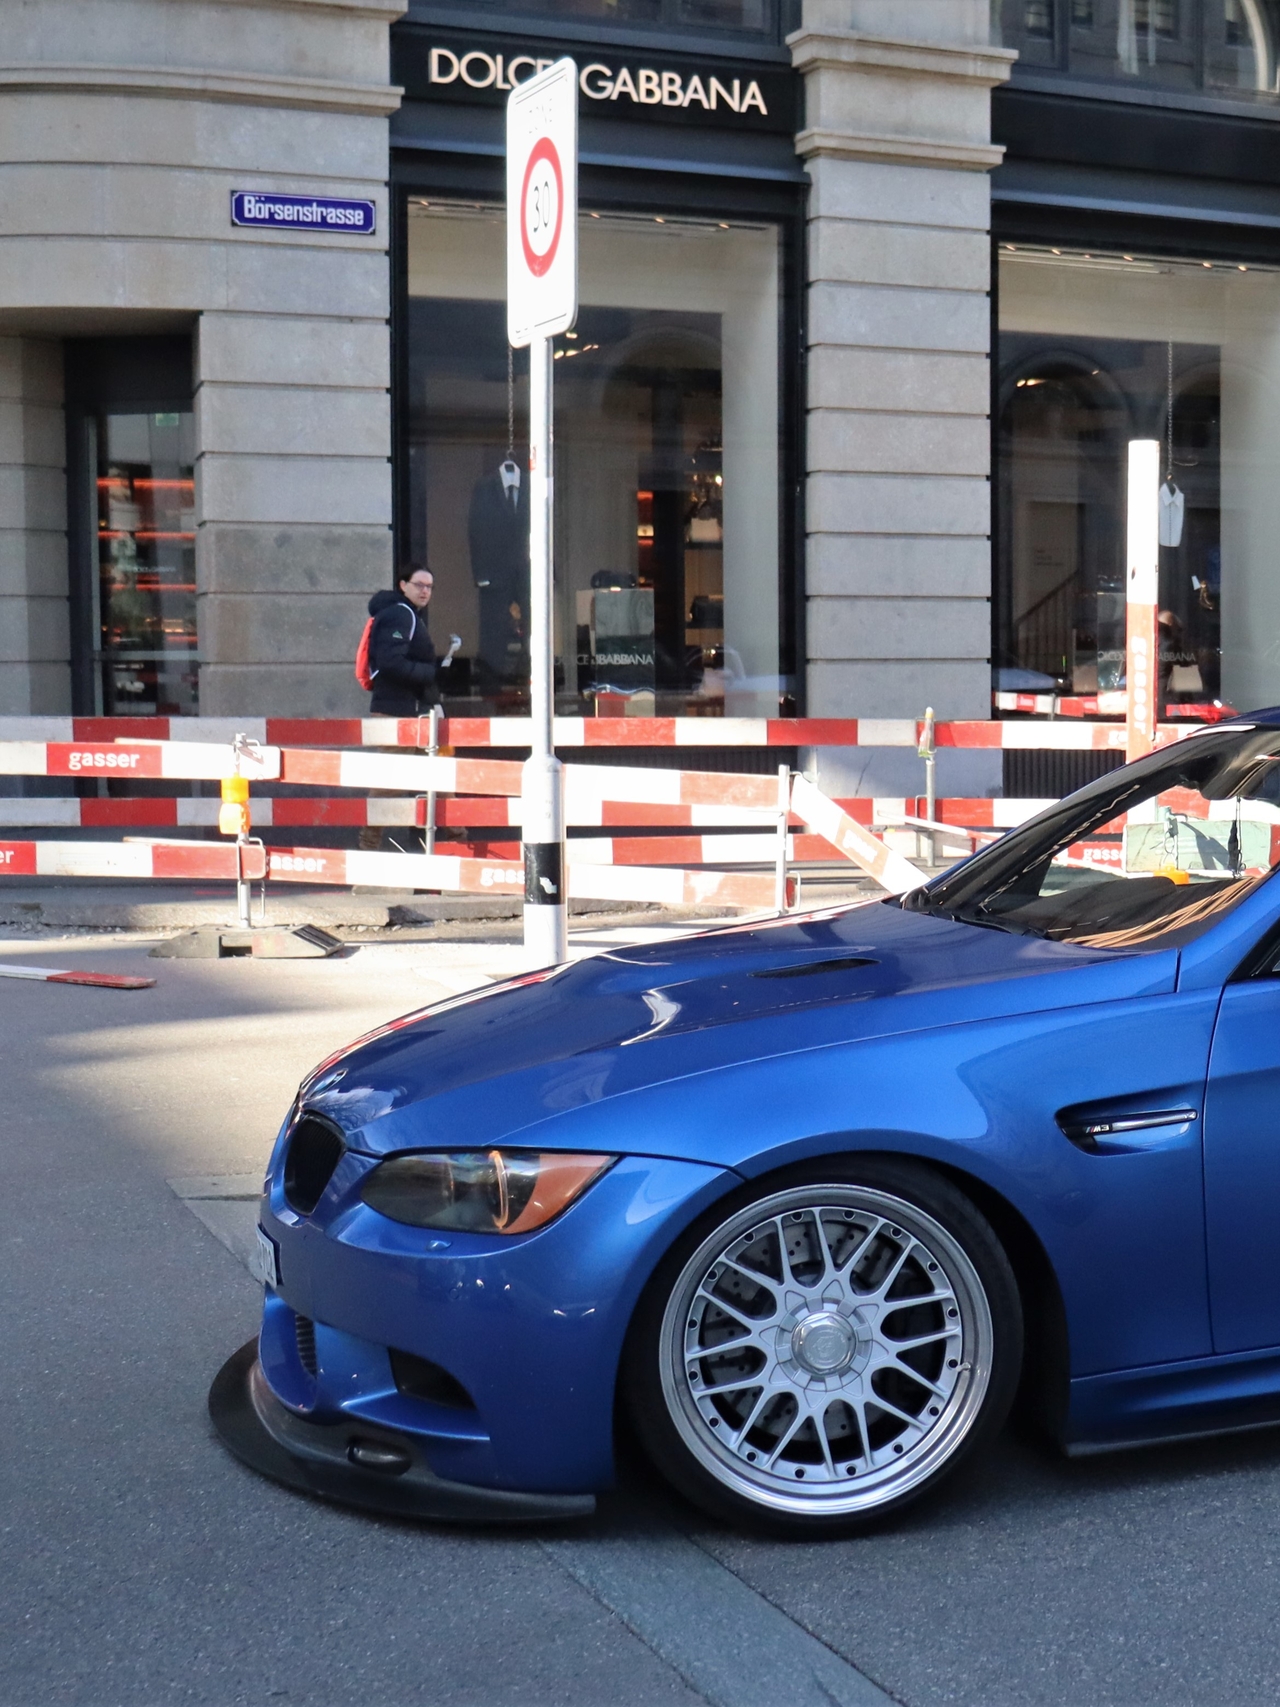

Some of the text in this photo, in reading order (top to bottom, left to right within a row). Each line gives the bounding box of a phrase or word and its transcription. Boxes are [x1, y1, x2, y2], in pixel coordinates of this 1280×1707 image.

[579, 63, 768, 115] GABBANA
[243, 195, 364, 226] Börsenstrasse
[533, 181, 550, 232] 30
[68, 752, 140, 770] gasser
[266, 855, 326, 873] asser
